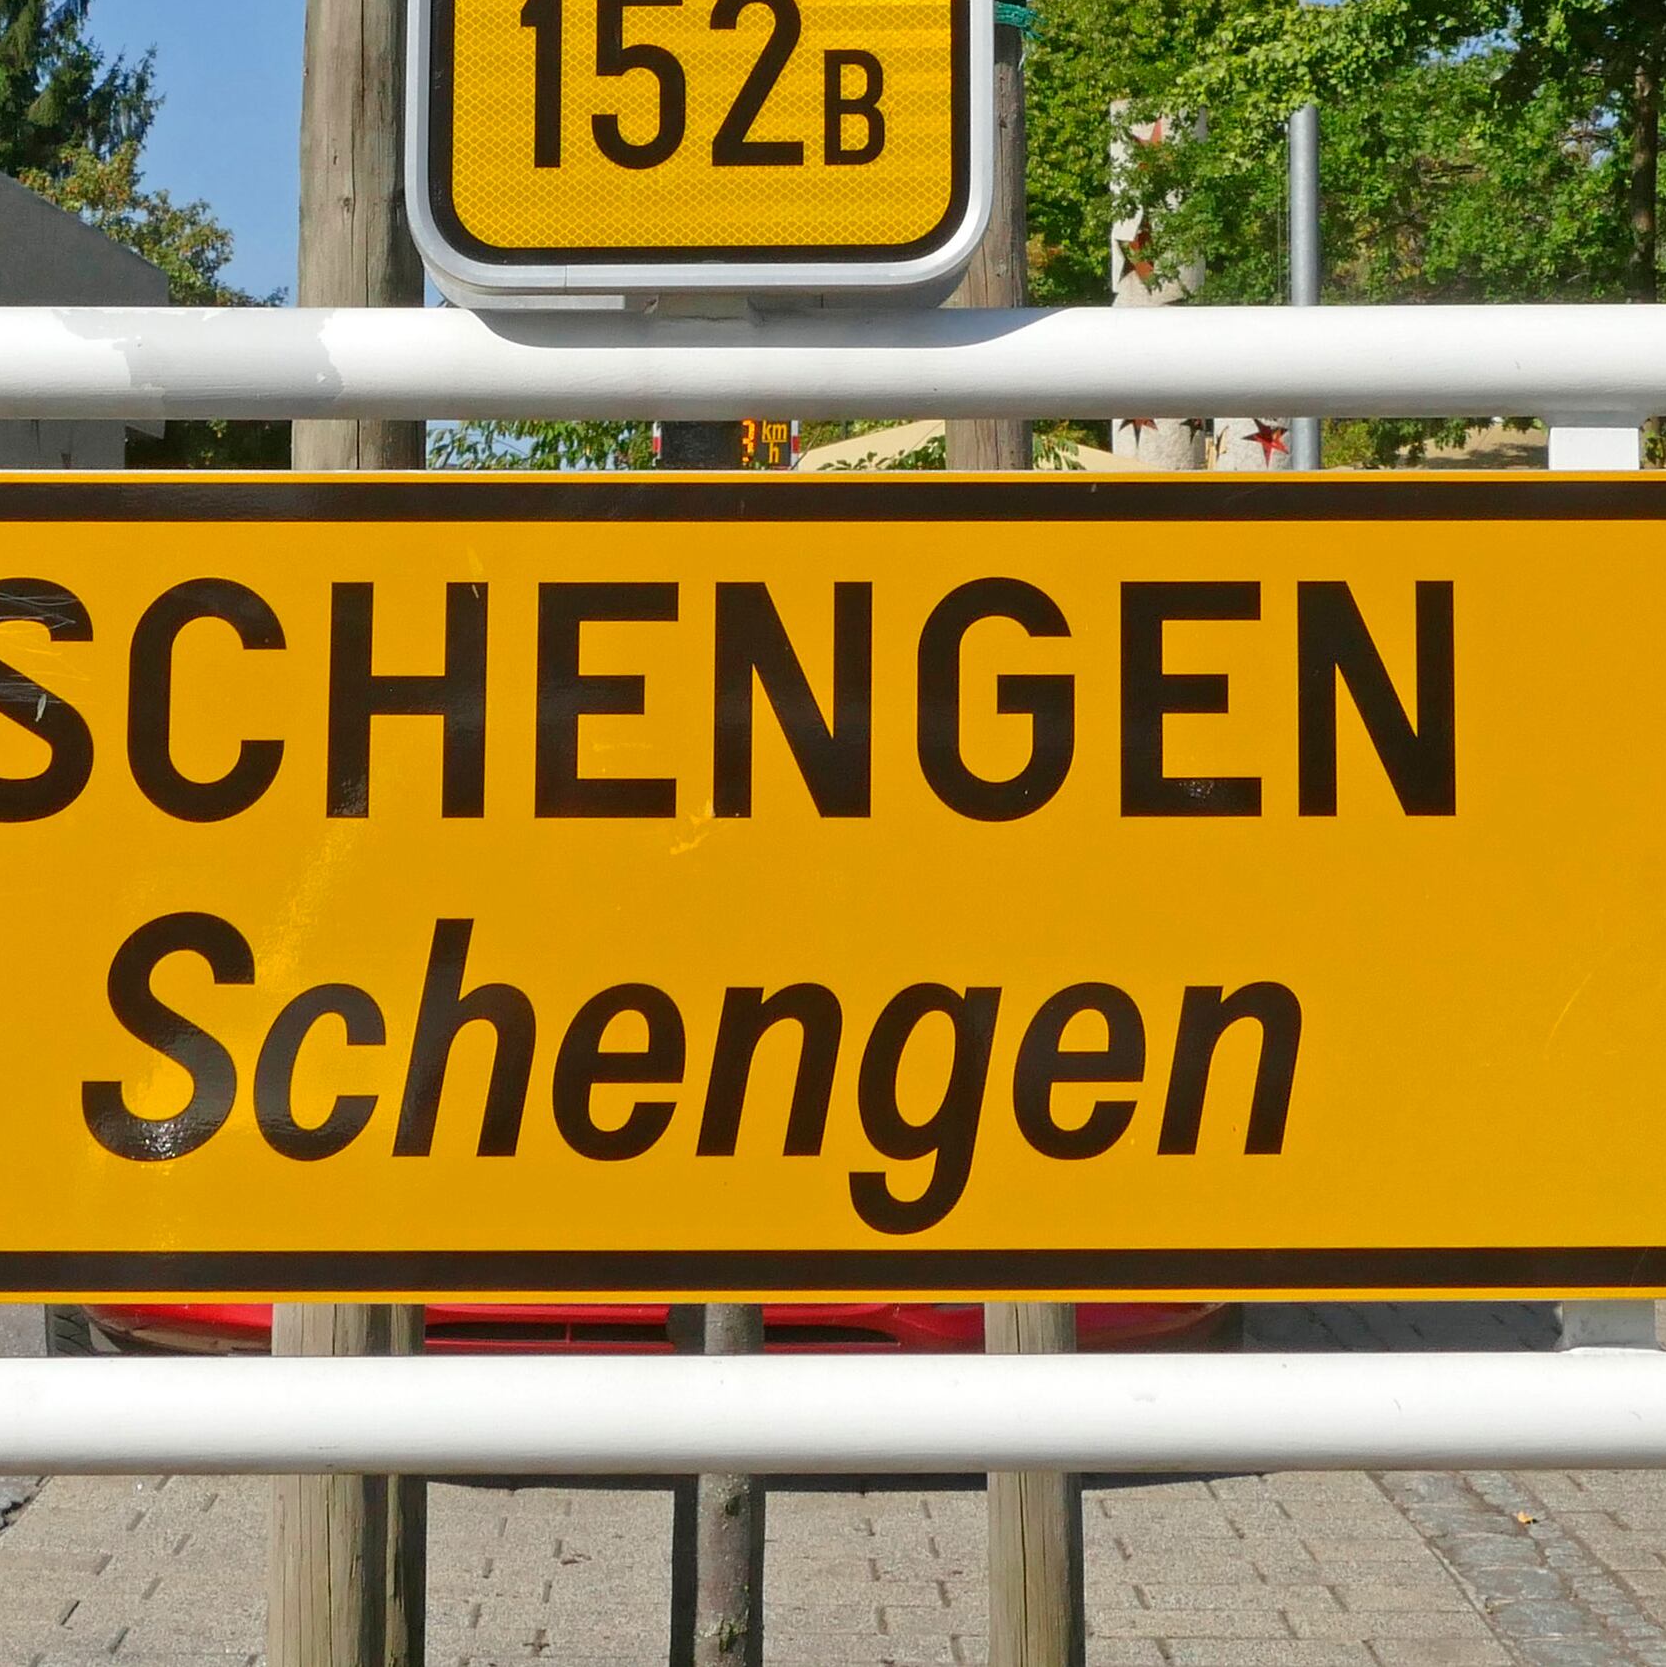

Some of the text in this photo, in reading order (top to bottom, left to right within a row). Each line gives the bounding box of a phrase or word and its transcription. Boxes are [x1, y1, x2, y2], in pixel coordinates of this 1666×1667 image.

[762, 420, 788, 441] km
[769, 442, 780, 464] h
[82, 912, 1302, 1236] Schengen
